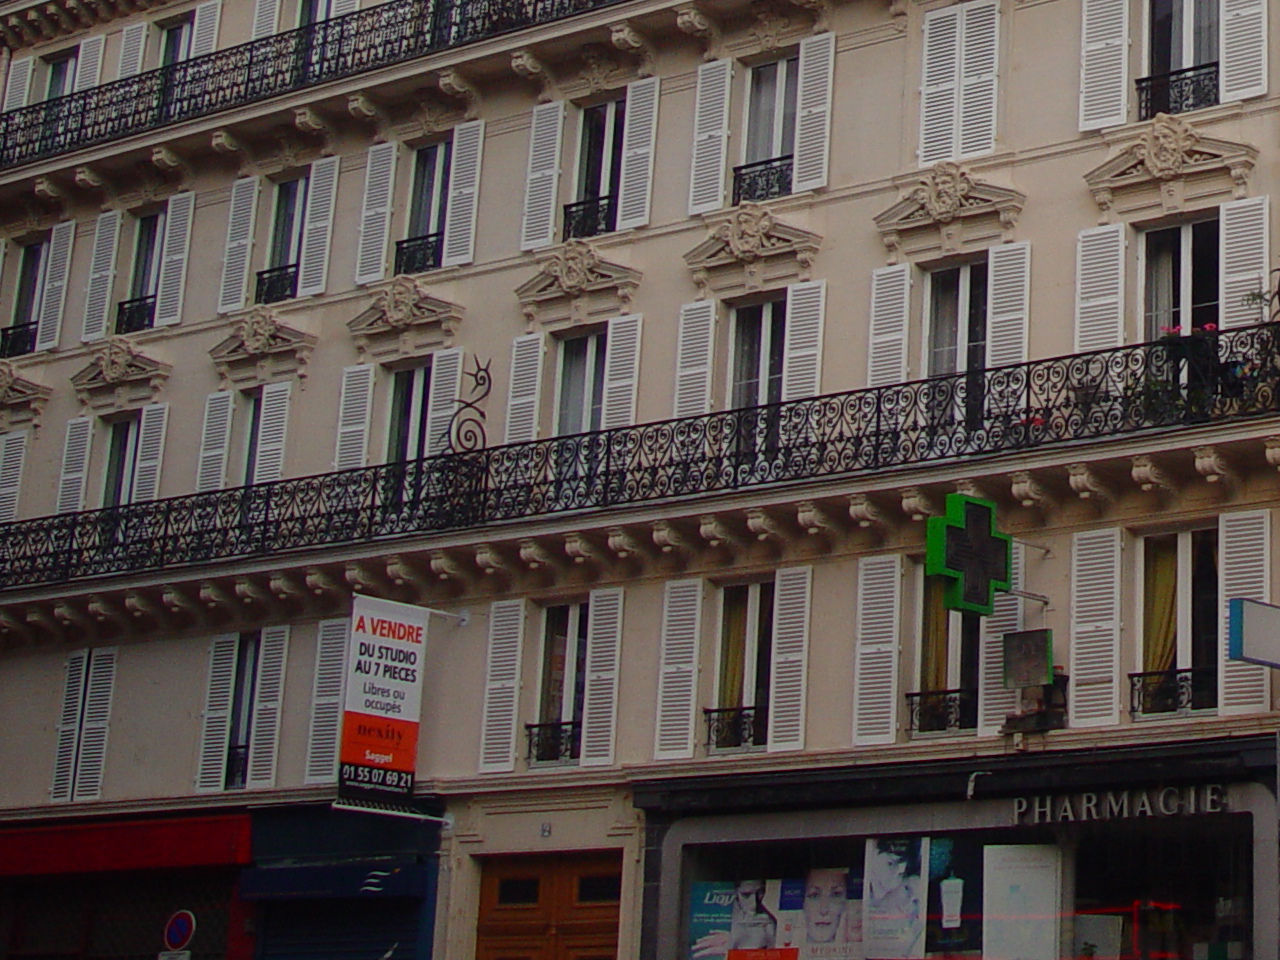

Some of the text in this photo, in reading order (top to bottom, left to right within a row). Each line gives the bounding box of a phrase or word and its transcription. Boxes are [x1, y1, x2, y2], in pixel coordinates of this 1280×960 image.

[355, 615, 423, 644] A VENDRE
[359, 642, 417, 665] DU STUDIO
[355, 659, 417, 683] AU 7 PIECES
[363, 682, 405, 700] Libres ou
[364, 698, 402, 714] occupés
[357, 724, 403, 747] nexity
[365, 749, 393, 764] Saggel
[342, 764, 412, 787] 01 55 07 69 21
[1013, 784, 1223, 825] PHARMACIE
